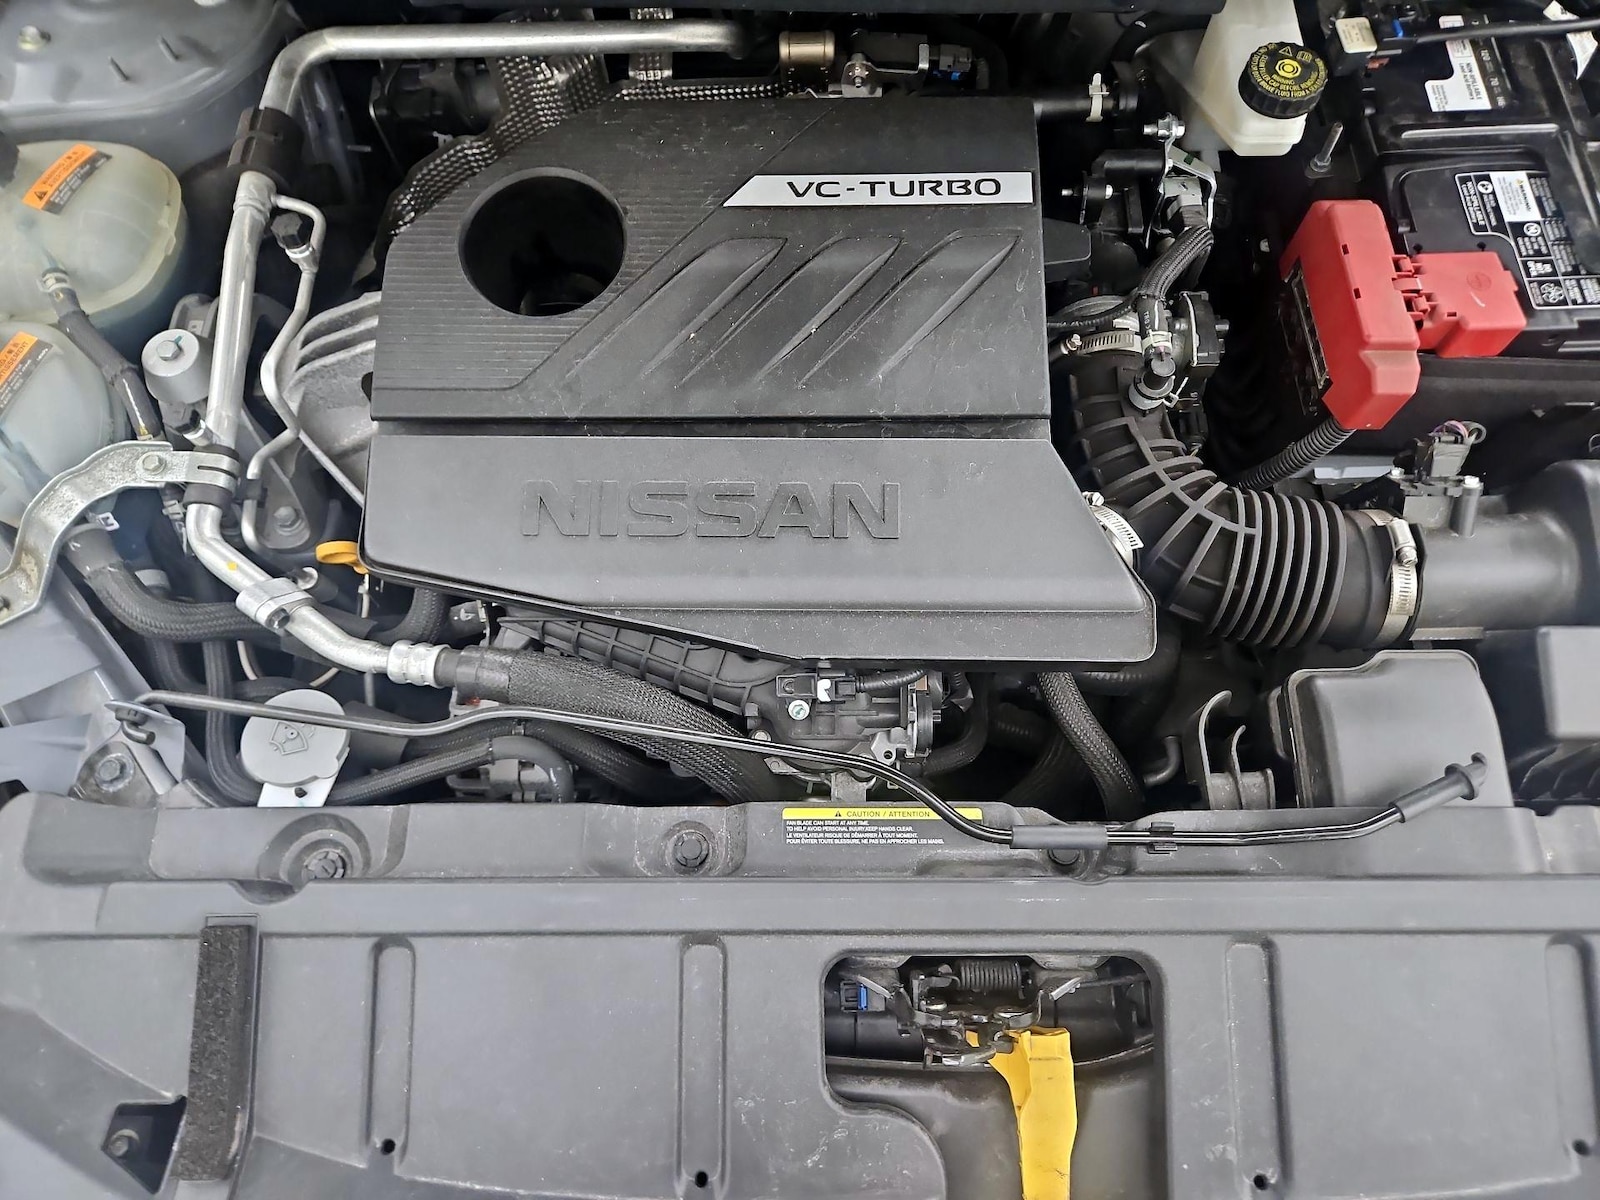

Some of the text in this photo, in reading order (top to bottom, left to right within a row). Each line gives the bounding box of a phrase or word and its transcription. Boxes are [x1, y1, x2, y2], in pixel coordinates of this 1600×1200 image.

[1269, 80, 1280, 88] CAP
[786, 178, 1002, 198] VC-TURBO
[1466, 181, 1485, 226] NON-SPILLABLE
[521, 480, 901, 539] NISSAN
